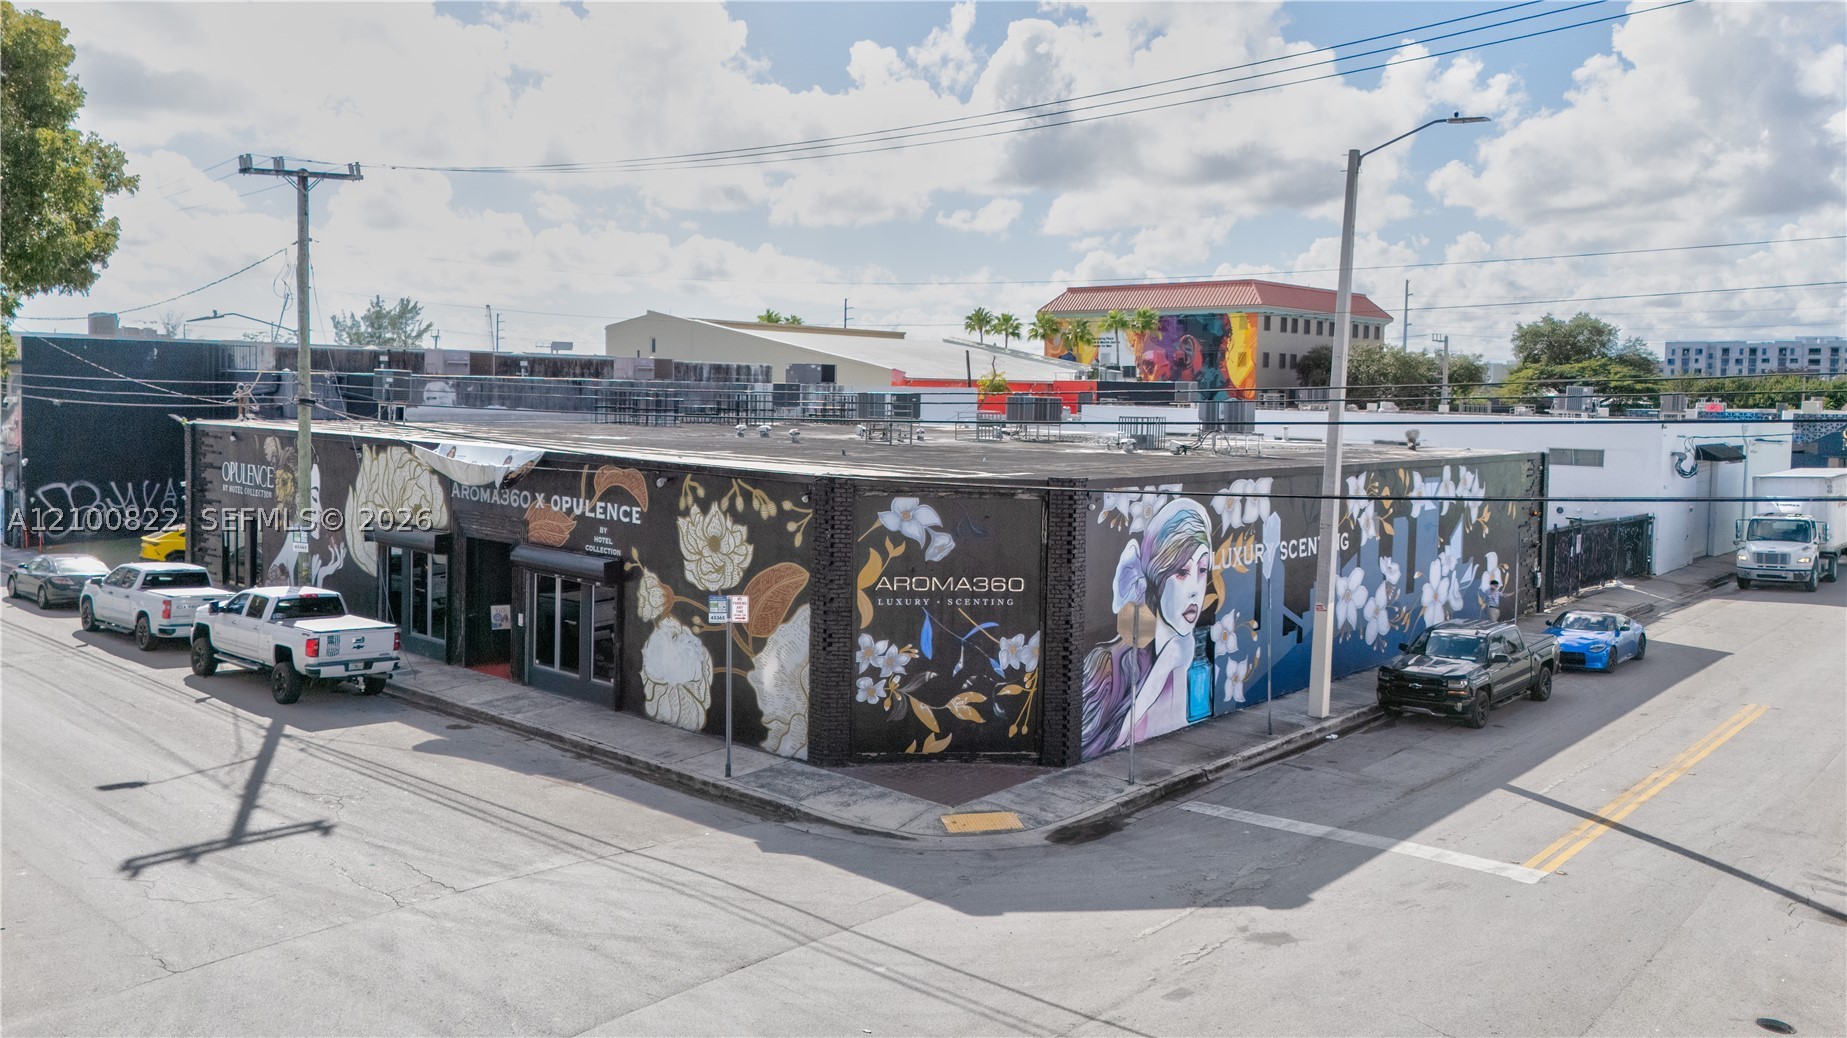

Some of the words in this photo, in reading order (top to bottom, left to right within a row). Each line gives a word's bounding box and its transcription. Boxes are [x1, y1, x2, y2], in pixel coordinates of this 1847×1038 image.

[222, 461, 274, 488] OPULENCE
[229, 485, 243, 494] HOTEL
[244, 488, 272, 498] COLLECTION
[451, 481, 531, 508] AROMA360
[550, 495, 642, 525] OPULENCE
[599, 526, 608, 534] BY
[593, 535, 613, 545] HOTEL
[584, 544, 622, 557] COLLECTION
[1212, 541, 1275, 571] LUXURY
[1280, 532, 1350, 561] SCENG
[875, 576, 1025, 592] AROMA360
[877, 598, 930, 606] LUXURY
[947, 598, 1014, 606] SCENTING
